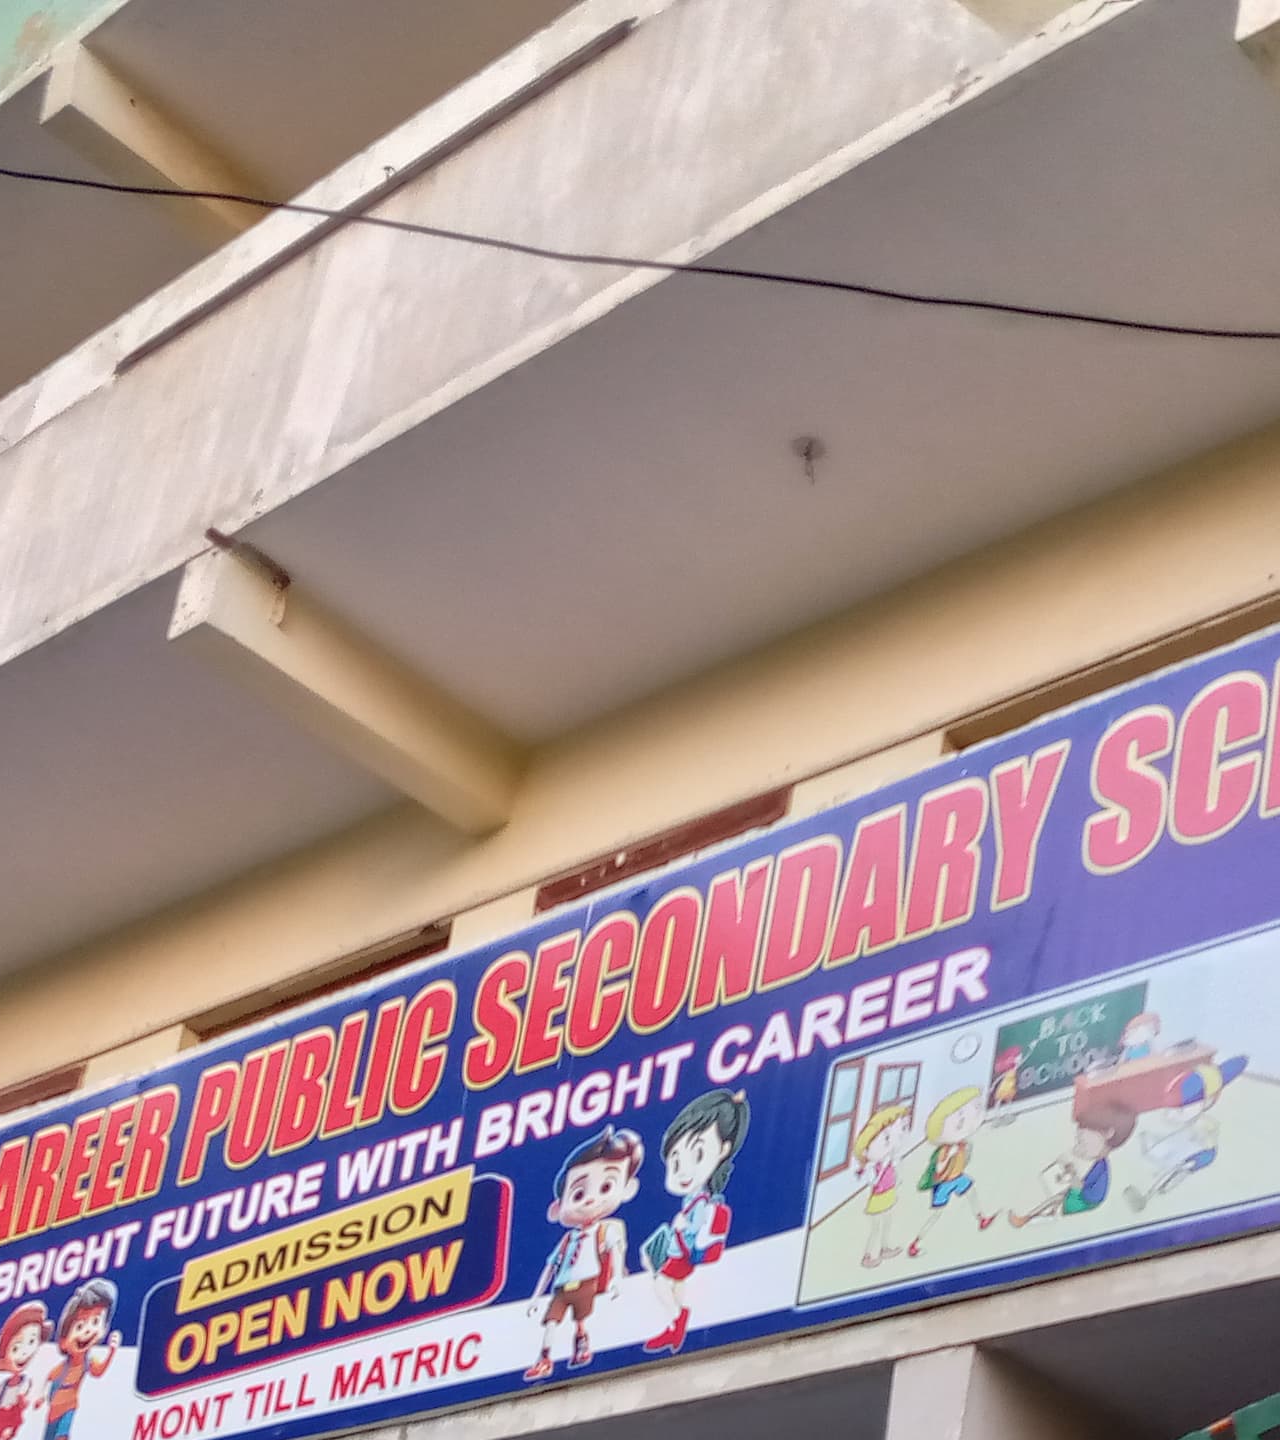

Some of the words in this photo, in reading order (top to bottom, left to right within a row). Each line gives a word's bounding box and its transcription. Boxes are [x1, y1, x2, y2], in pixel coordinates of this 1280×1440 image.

[177, 980, 457, 1185] PUBLIC
[463, 739, 1071, 1090] SECONDARY
[145, 1162, 325, 1262] FUTURE
[336, 1117, 464, 1220] WITH
[474, 1042, 694, 1159] BRIGHT
[705, 947, 990, 1085] CAREER
[164, 1285, 306, 1376] OPEN
[322, 1239, 466, 1330] NOW
[192, 1188, 454, 1299] ADMISSION
[245, 1368, 316, 1422] TILL
[329, 1332, 483, 1403] MATRIC
